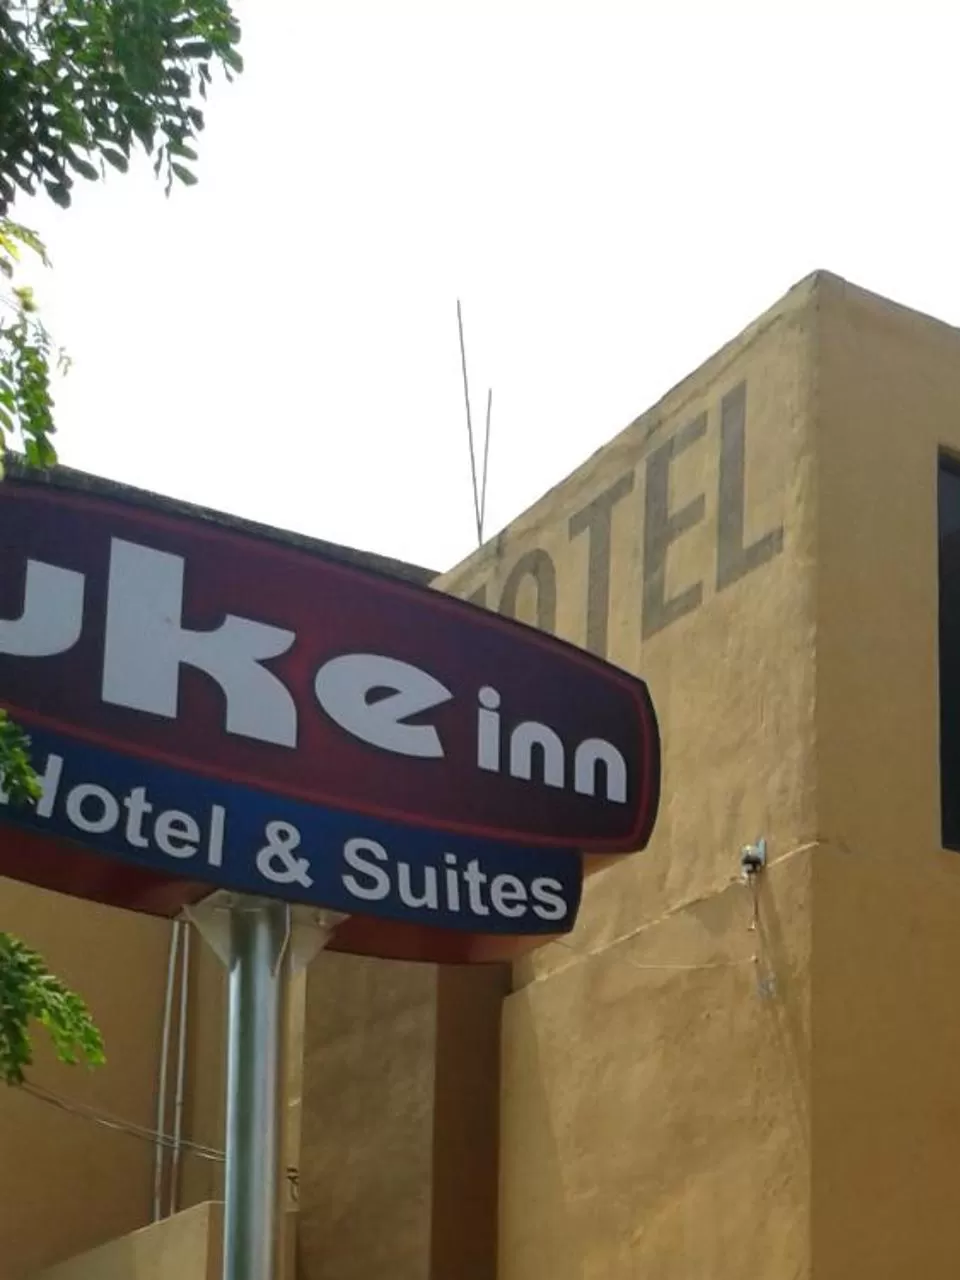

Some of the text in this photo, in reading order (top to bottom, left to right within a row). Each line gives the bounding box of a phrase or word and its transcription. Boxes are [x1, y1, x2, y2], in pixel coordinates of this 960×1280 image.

[462, 379, 784, 662] OTEL
[255, 820, 313, 888] &
[342, 837, 567, 921] Suites
